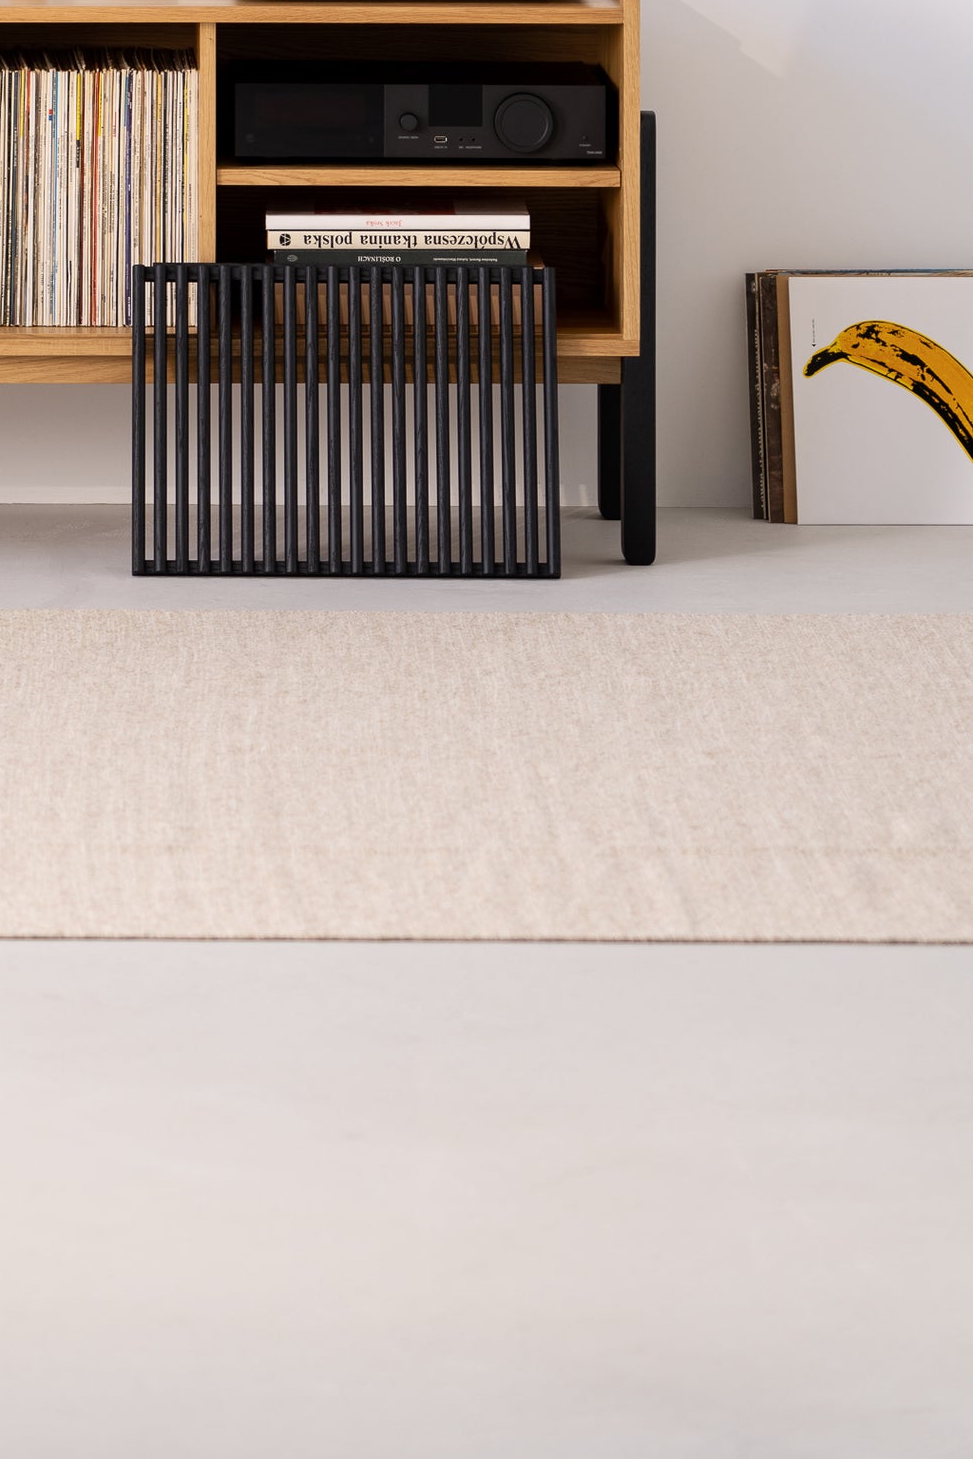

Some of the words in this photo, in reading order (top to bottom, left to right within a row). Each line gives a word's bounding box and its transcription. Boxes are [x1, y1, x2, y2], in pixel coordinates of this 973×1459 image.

[303, 232, 353, 247] polska
[360, 233, 418, 248] tkanina
[424, 232, 521, 250] Współczesna
